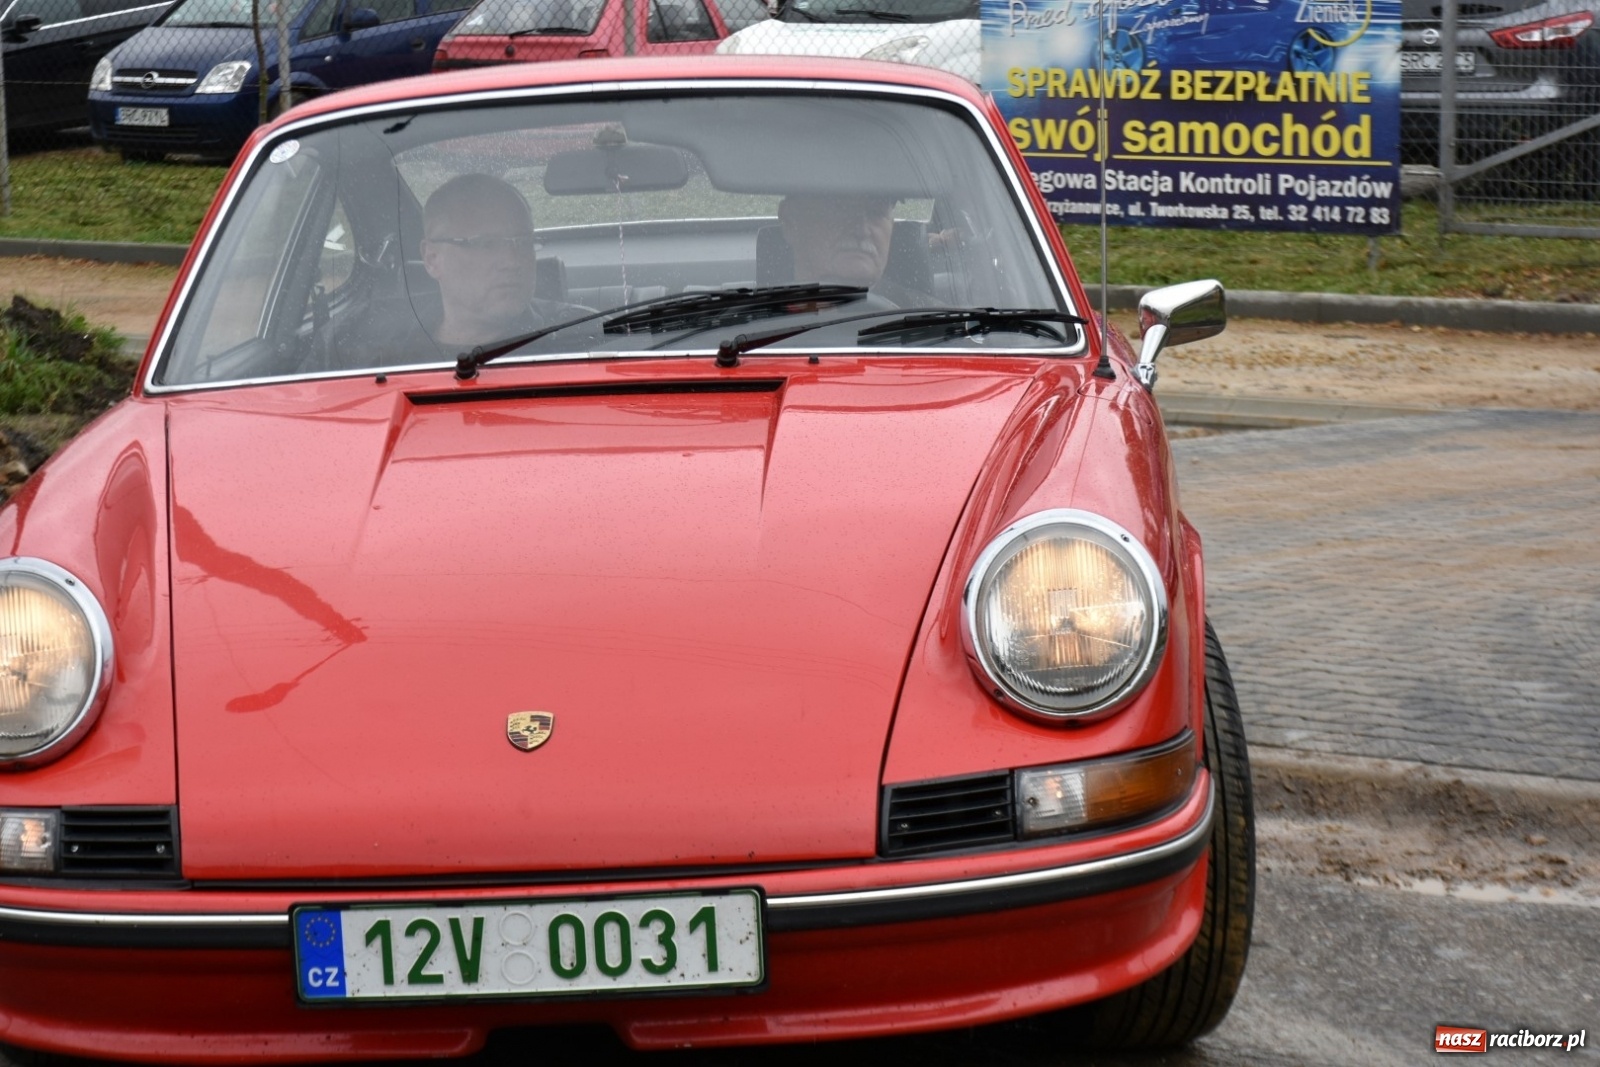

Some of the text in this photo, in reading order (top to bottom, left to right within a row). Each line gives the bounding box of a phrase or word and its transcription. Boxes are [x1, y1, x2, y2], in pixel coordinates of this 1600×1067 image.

[1007, 60, 1371, 103] SPRAWDŹ BEZPŁATNIE
[1008, 105, 1372, 161] swój samochód
[1104, 169, 1173, 197] Stacja
[1179, 170, 1271, 196] Kontroli
[1278, 173, 1393, 201] Pojazdów
[1128, 199, 1145, 216] ul.
[1150, 201, 1229, 219] Tworkowska
[1232, 204, 1255, 222] 25,
[1259, 205, 1284, 221] tel.
[1287, 204, 1308, 221] 32
[1311, 204, 1341, 223] 414
[1345, 206, 1366, 223] 72
[364, 906, 719, 987] 12V 0031
[307, 966, 340, 988] CZ
